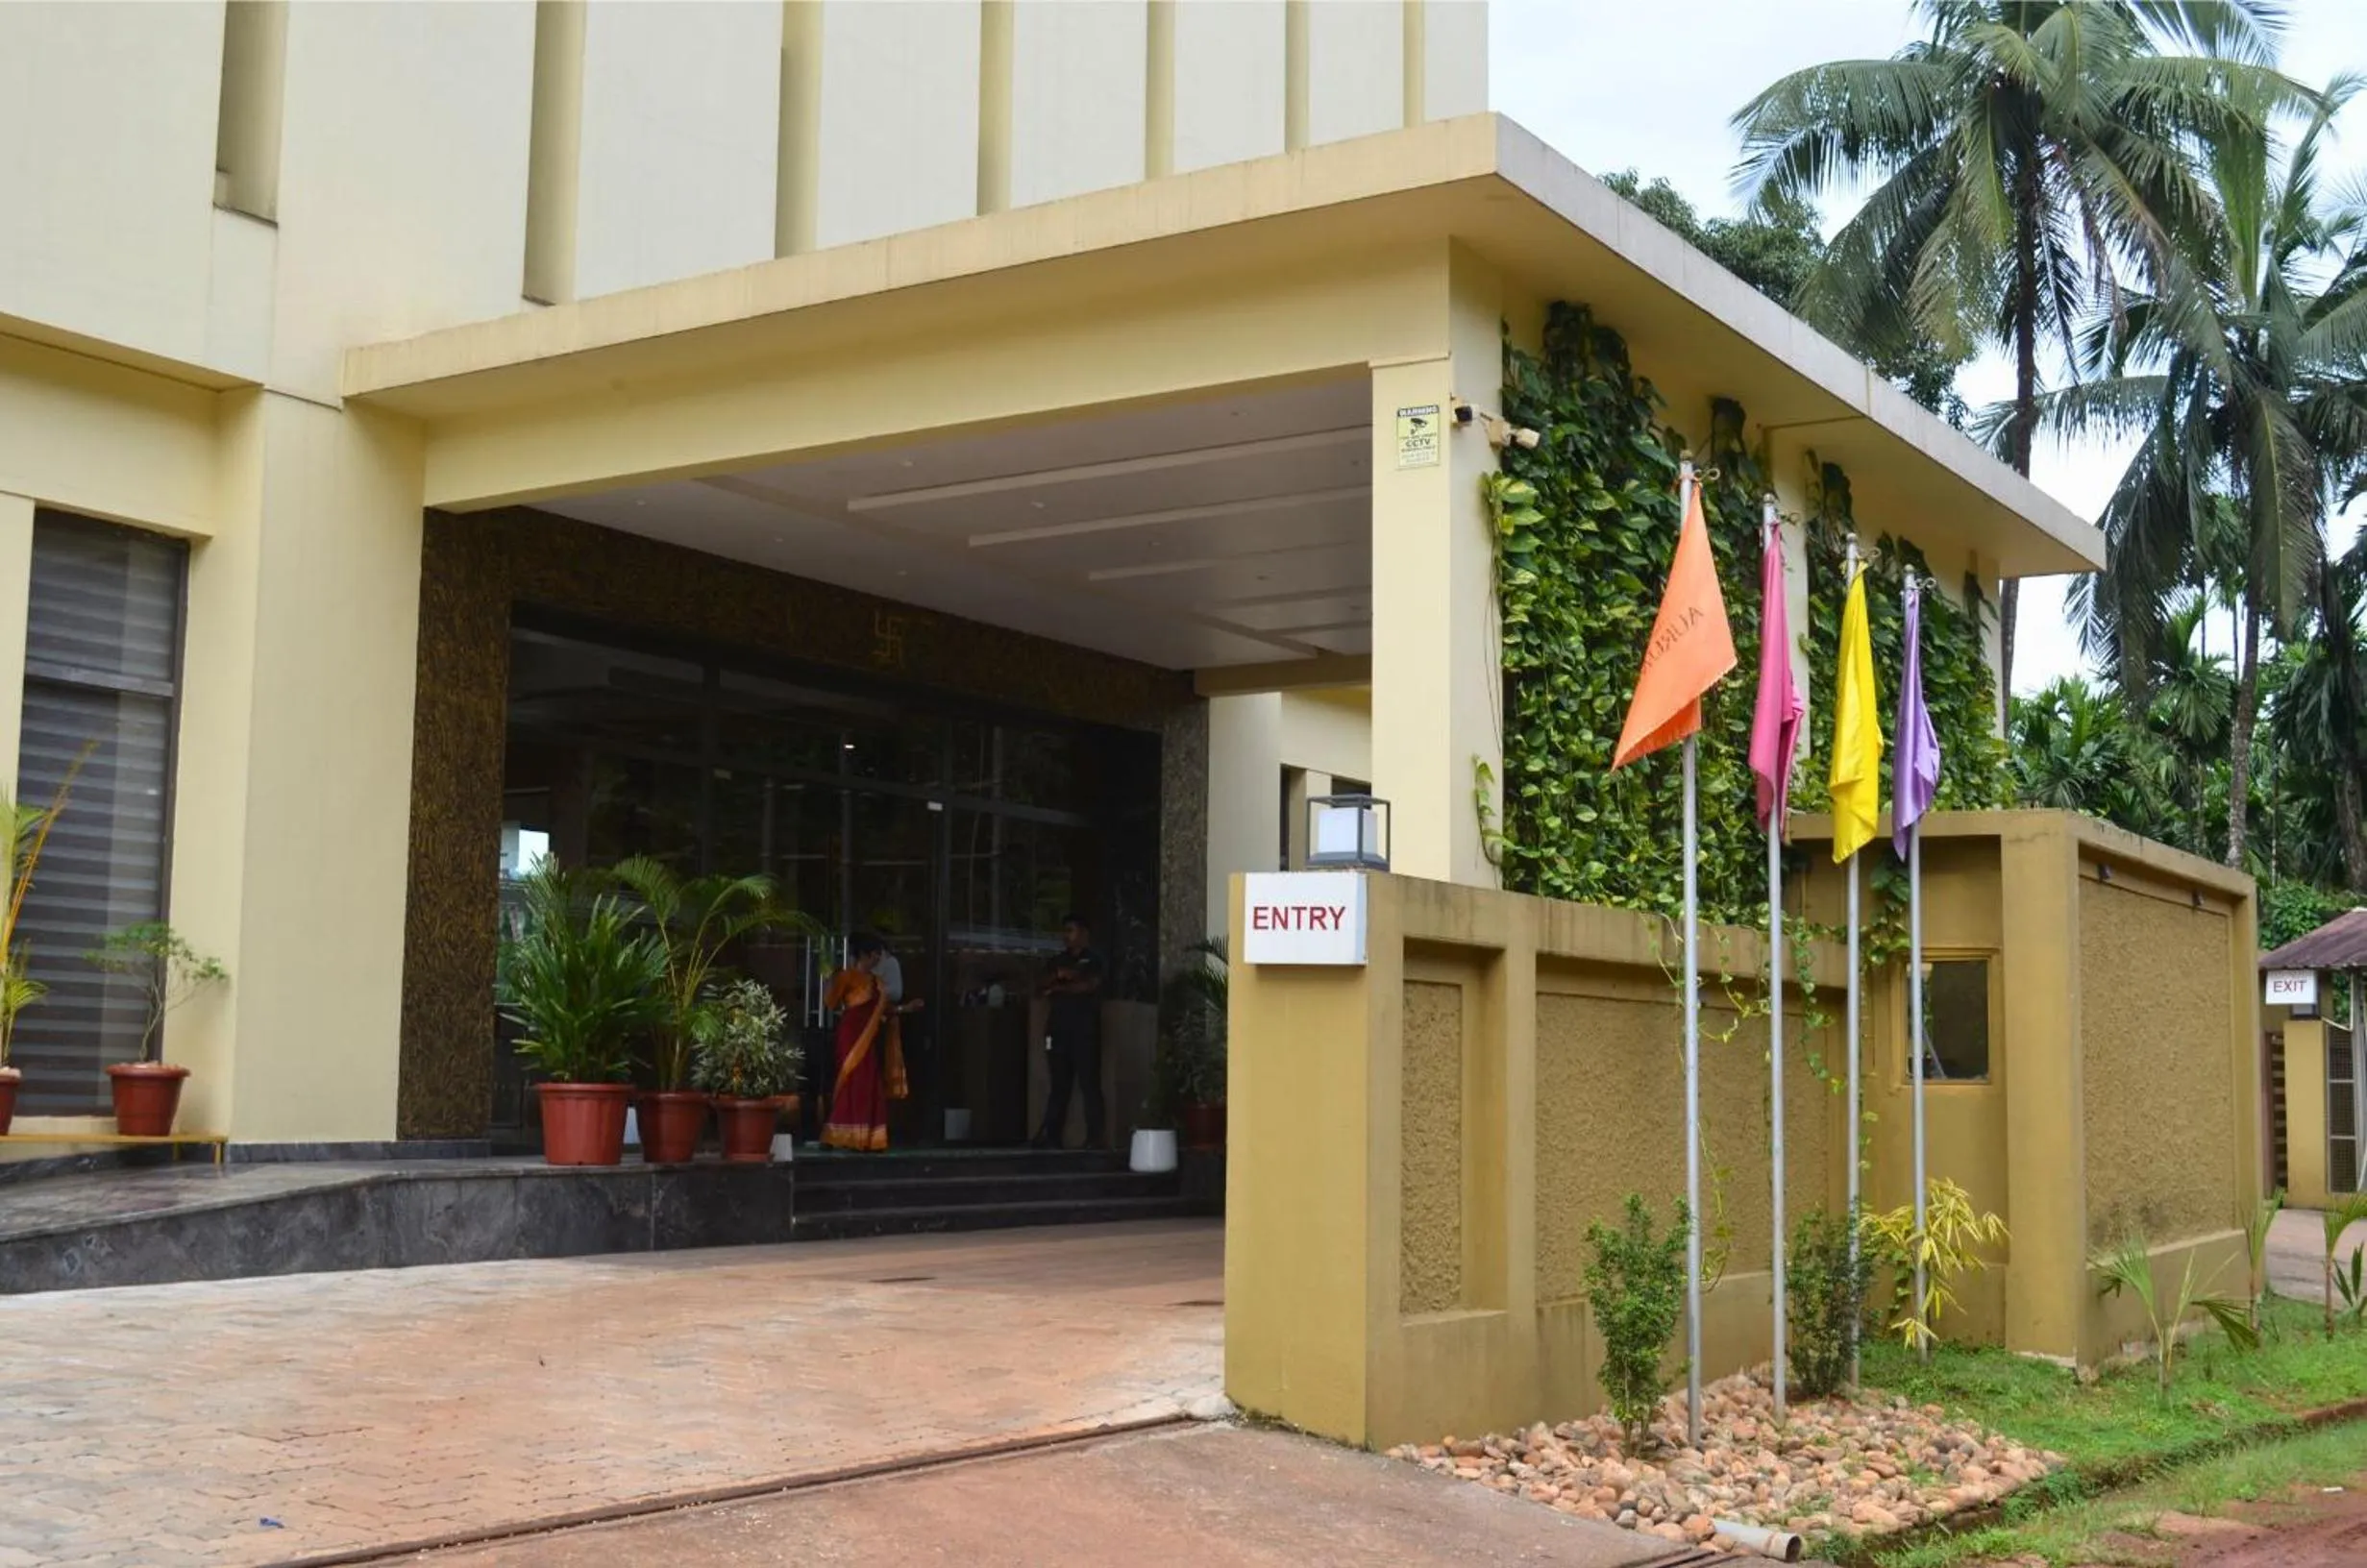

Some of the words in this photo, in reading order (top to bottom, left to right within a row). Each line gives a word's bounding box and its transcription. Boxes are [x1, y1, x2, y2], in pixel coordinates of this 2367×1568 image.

[1405, 438, 1431, 448] CCTV
[1252, 905, 1346, 931] ENTRY
[2273, 980, 2307, 992] EXIT
